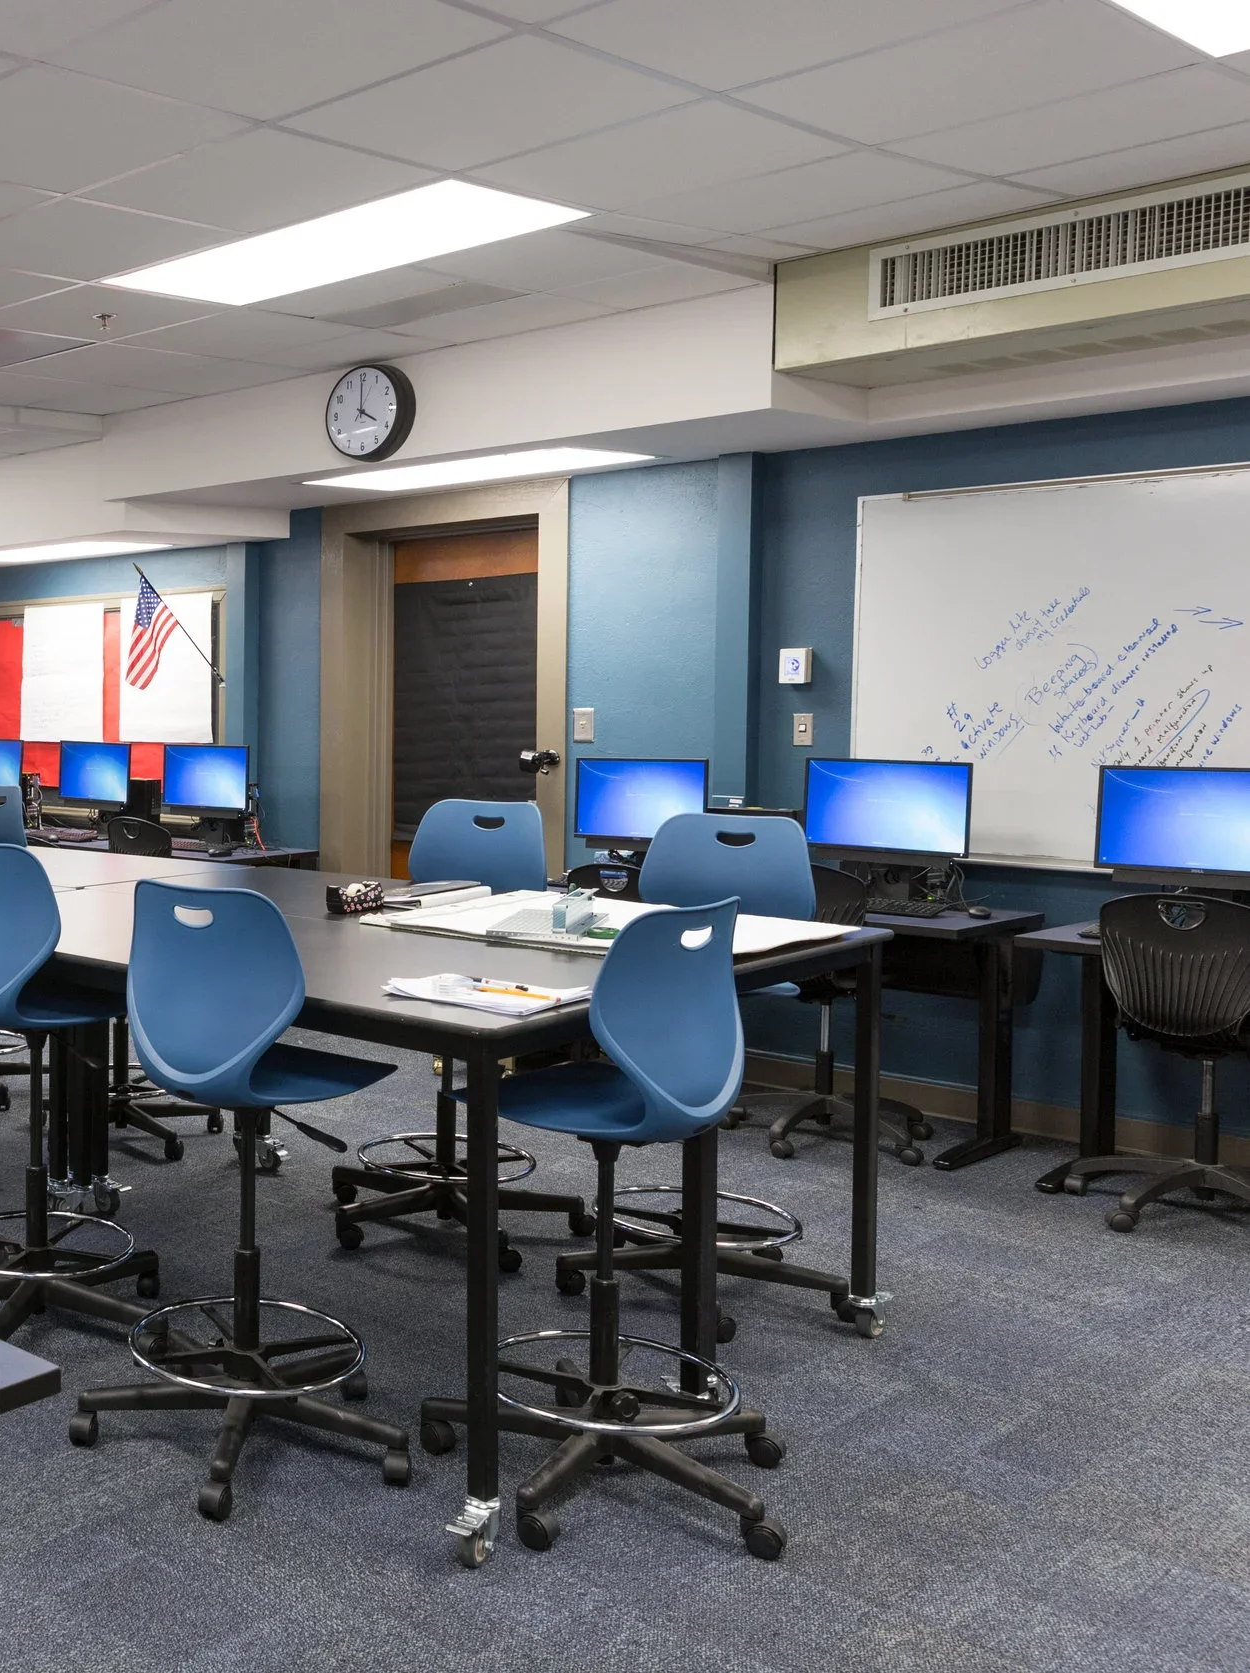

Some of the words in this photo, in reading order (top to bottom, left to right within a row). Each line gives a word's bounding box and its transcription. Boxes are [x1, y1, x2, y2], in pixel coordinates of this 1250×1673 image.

[359, 372, 367, 382] 12
[375, 375, 379, 384] 1
[346, 380, 353, 390] 11
[384, 386, 390, 395] 2
[336, 394, 344, 404] 10
[333, 412, 339, 421] 9
[384, 420, 389, 429] 4
[346, 439, 351, 449] 7
[374, 435, 379, 444] 5
[360, 441, 365, 451] 6
